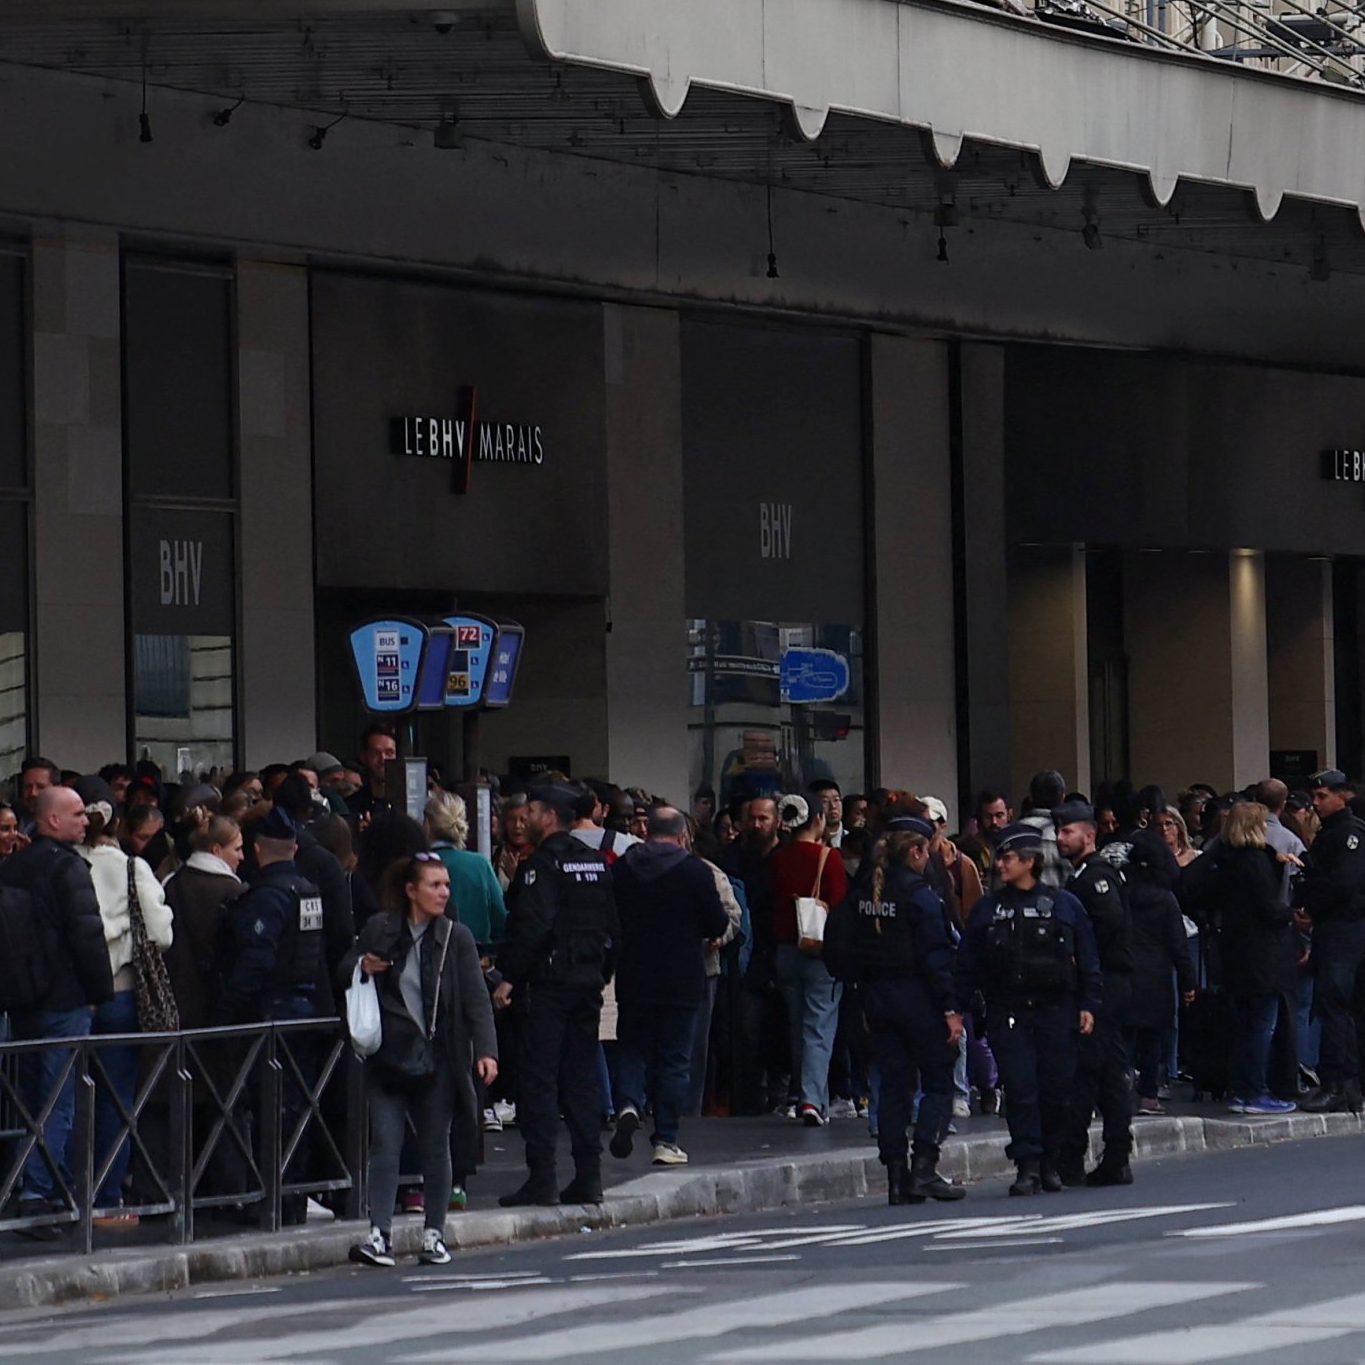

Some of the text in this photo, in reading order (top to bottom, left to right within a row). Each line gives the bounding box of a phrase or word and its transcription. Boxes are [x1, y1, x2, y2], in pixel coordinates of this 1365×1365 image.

[404, 416, 544, 465] LE BHV MARAIS
[1334, 450, 1350, 481] LE
[759, 502, 793, 561] BHV
[159, 539, 203, 607] BHV
[379, 636, 396, 646] BUS
[459, 627, 478, 641] 72
[449, 674, 466, 688] 96
[562, 861, 606, 873] GENDARMERIE
